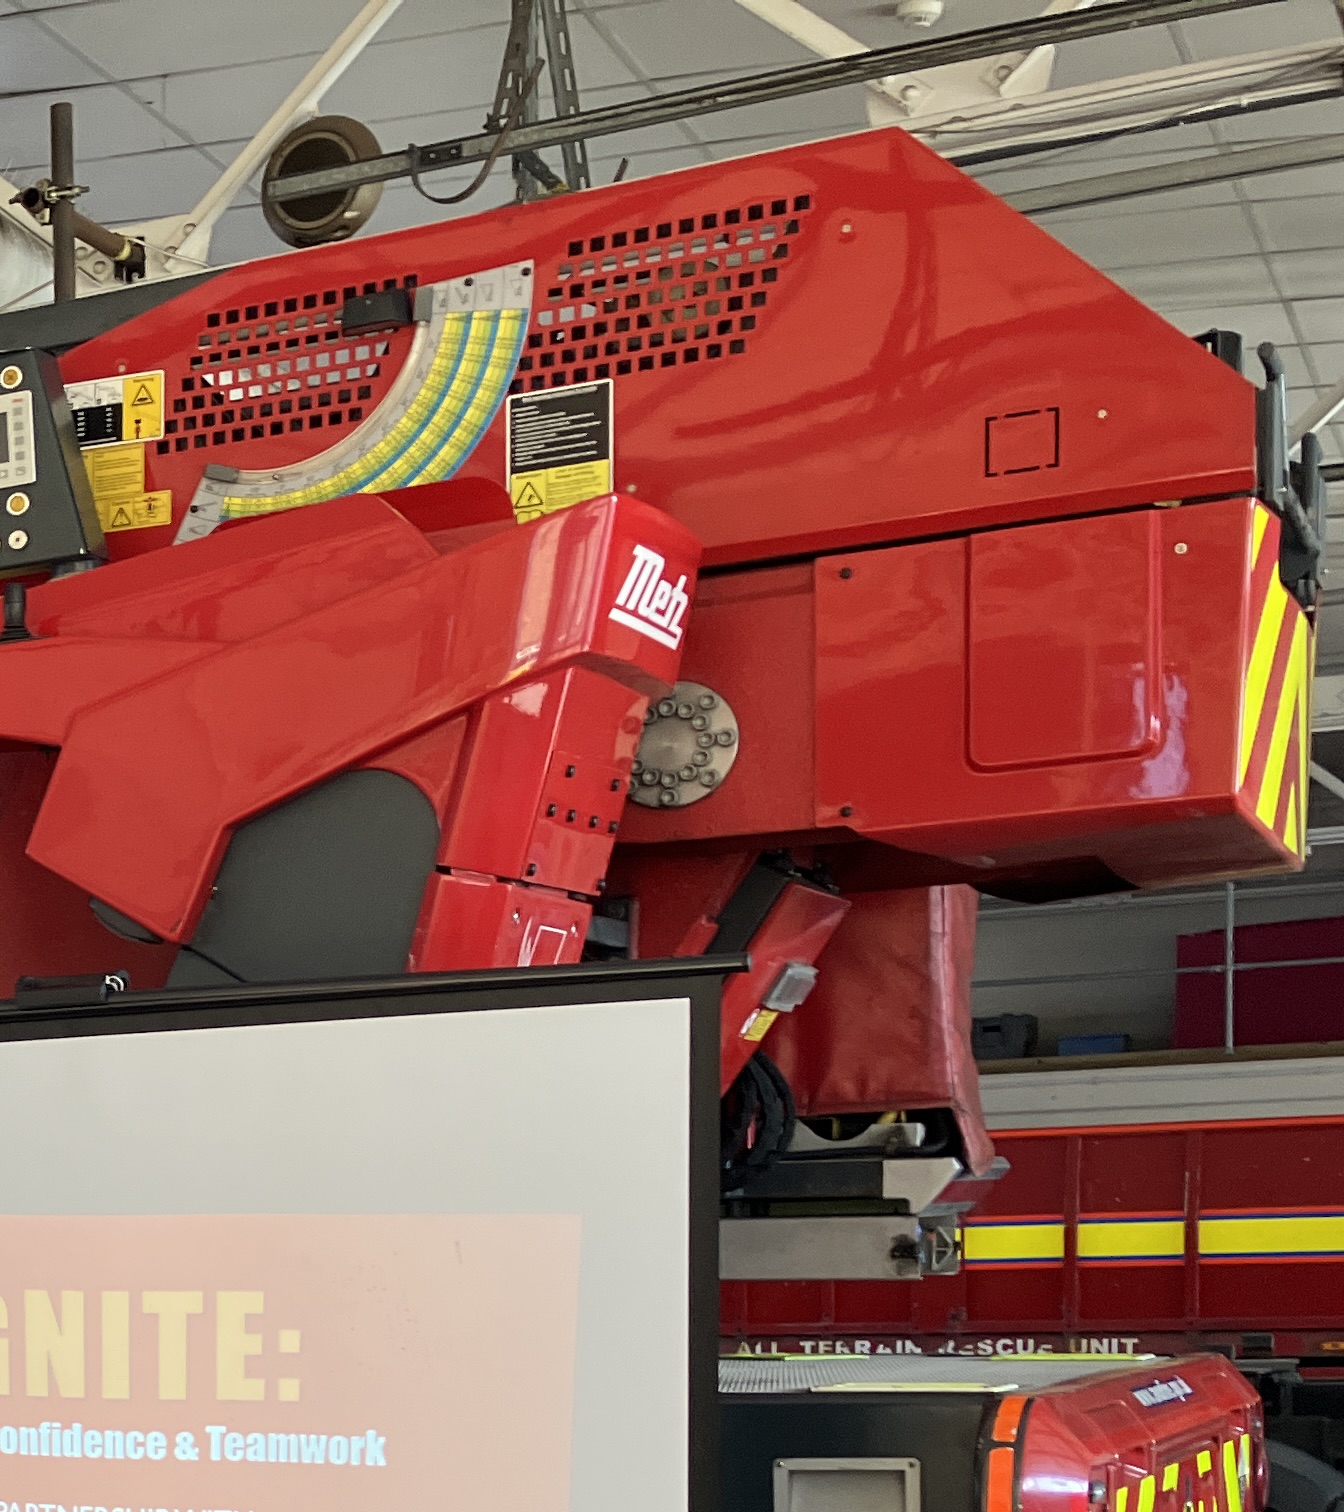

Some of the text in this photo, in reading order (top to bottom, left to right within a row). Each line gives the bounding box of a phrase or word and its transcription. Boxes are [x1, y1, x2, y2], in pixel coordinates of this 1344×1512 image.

[1069, 1338, 1139, 1355] UNIT
[174, 1431, 199, 1461] &
[205, 1425, 387, 1466] Teamwork
